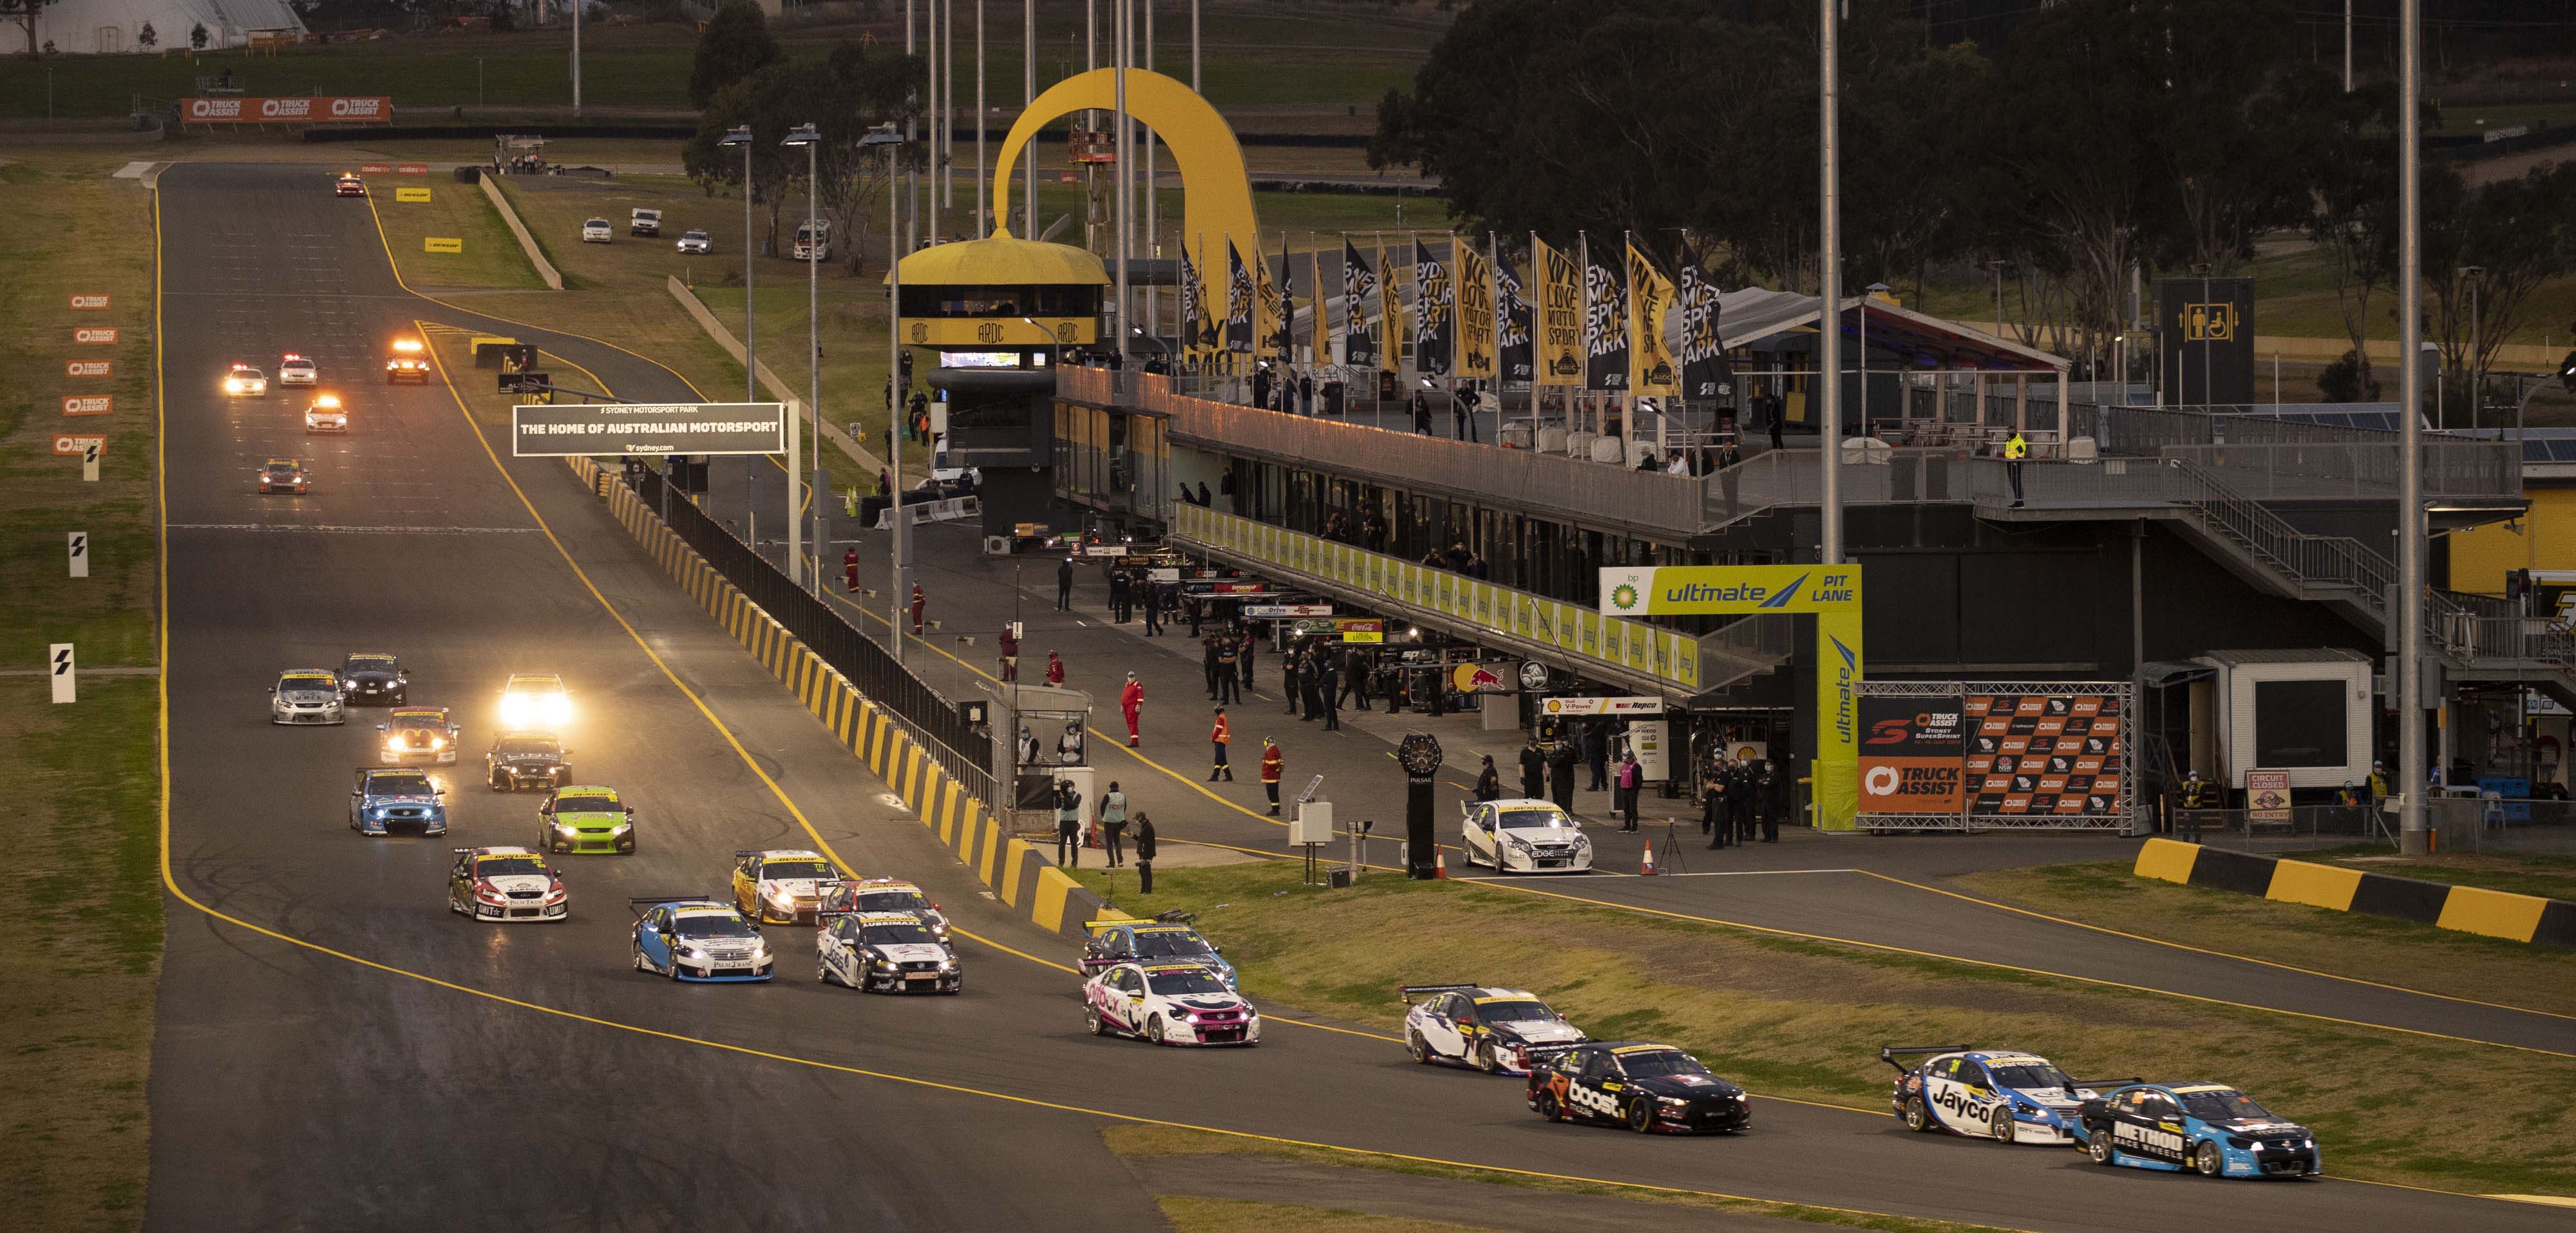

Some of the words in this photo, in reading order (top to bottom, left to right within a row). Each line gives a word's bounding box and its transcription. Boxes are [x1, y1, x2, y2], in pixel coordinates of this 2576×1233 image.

[348, 107, 378, 115] ASSIST
[1547, 284, 1577, 310] LOVE
[1548, 310, 1577, 326] MOTO
[911, 322, 928, 343] ARDC
[978, 323, 1004, 343] ARDC
[1057, 322, 1078, 343] ARDC
[520, 424, 545, 434] THE
[549, 423, 585, 434] HOME
[588, 423, 605, 434] OF
[607, 423, 687, 434] AUSTRALIAN
[690, 422, 778, 432] MOTORSPORT
[1824, 575, 1848, 586] PIT
[1667, 582, 1766, 602] ultimate
[1812, 589, 1853, 602] LANE
[1836, 666, 1851, 745] ultimate
[1902, 767, 1960, 780] TRUCK
[1897, 781, 1958, 795] ASSIST
[478, 905, 493, 915] UNIT
[549, 904, 564, 914] UNIT
[1569, 1078, 1620, 1118] boost
[1933, 1084, 1989, 1123] Jayco
[2114, 1120, 2184, 1151] METHOD
[2114, 1136, 2139, 1150] RACE
[2141, 1142, 2183, 1160] WHEELS
